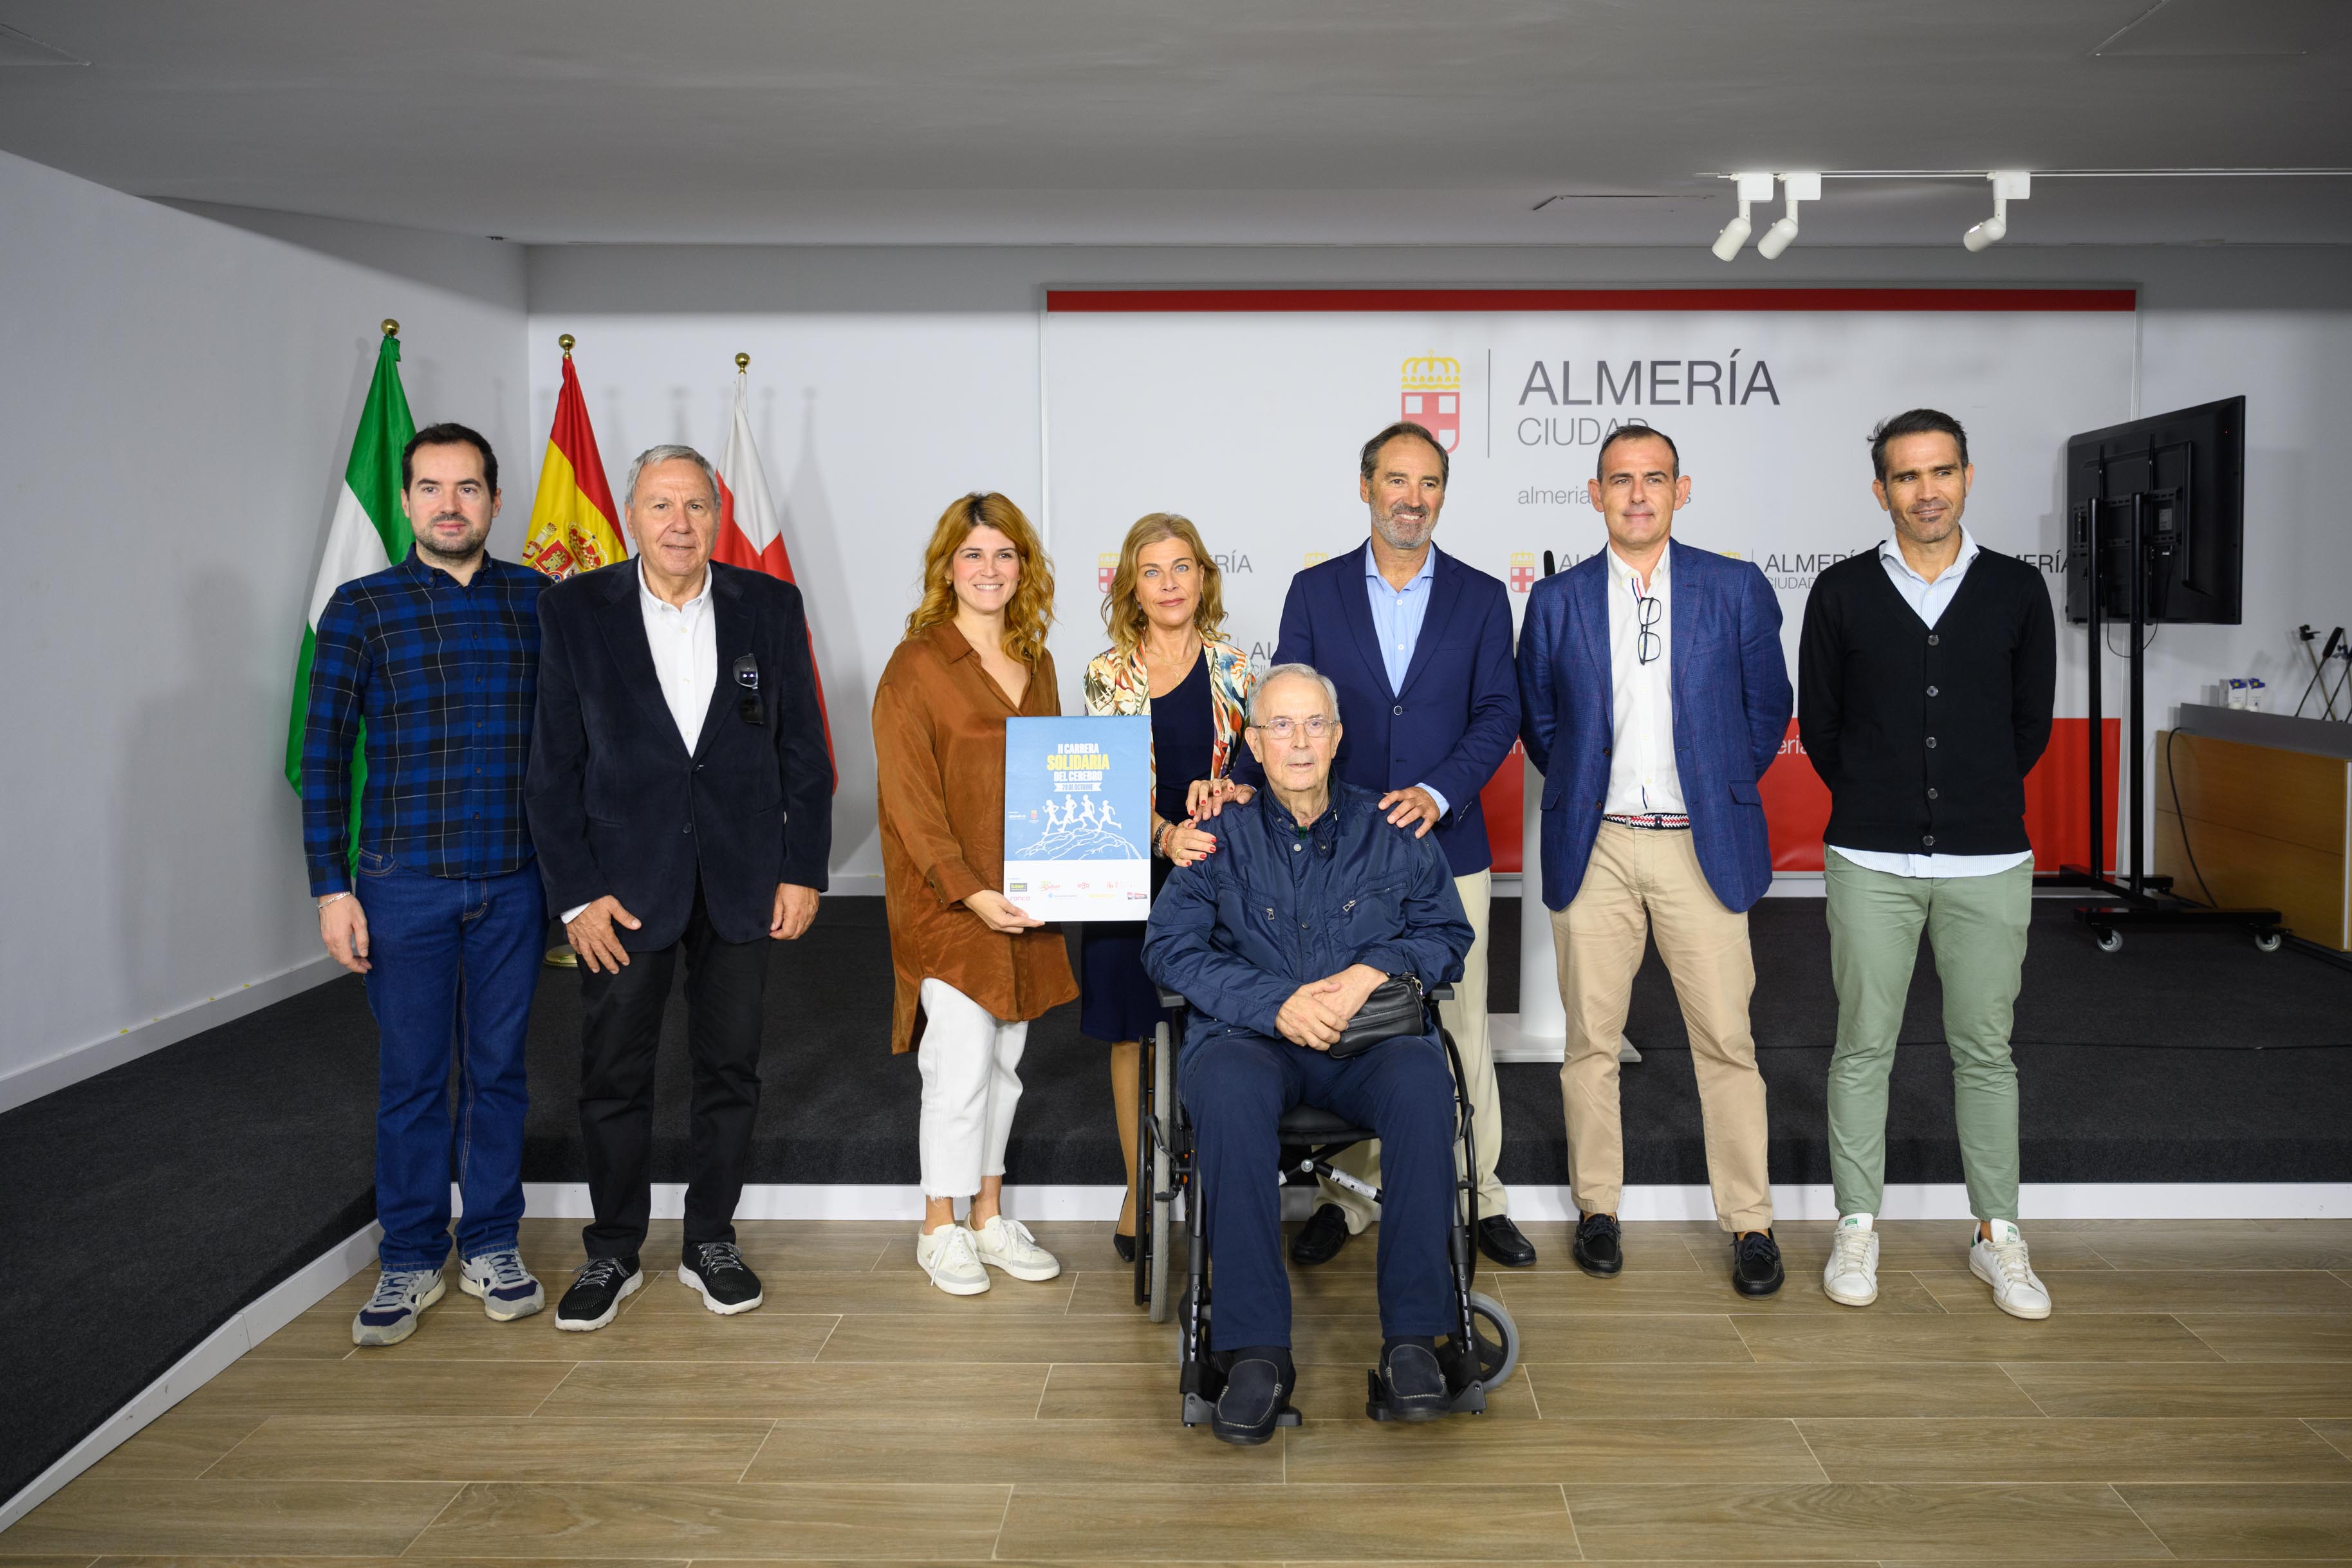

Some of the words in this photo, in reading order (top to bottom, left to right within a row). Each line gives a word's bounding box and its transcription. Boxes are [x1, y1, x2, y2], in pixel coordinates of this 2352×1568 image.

[1518, 348, 1781, 406] ALMERÍA
[1517, 418, 1649, 446] CIUDA
[1064, 742, 1100, 754] CARRERA
[1046, 753, 1110, 771] SOLIDARIA
[1053, 771, 1068, 782] DEL
[1068, 771, 1103, 782] CEREBRO
